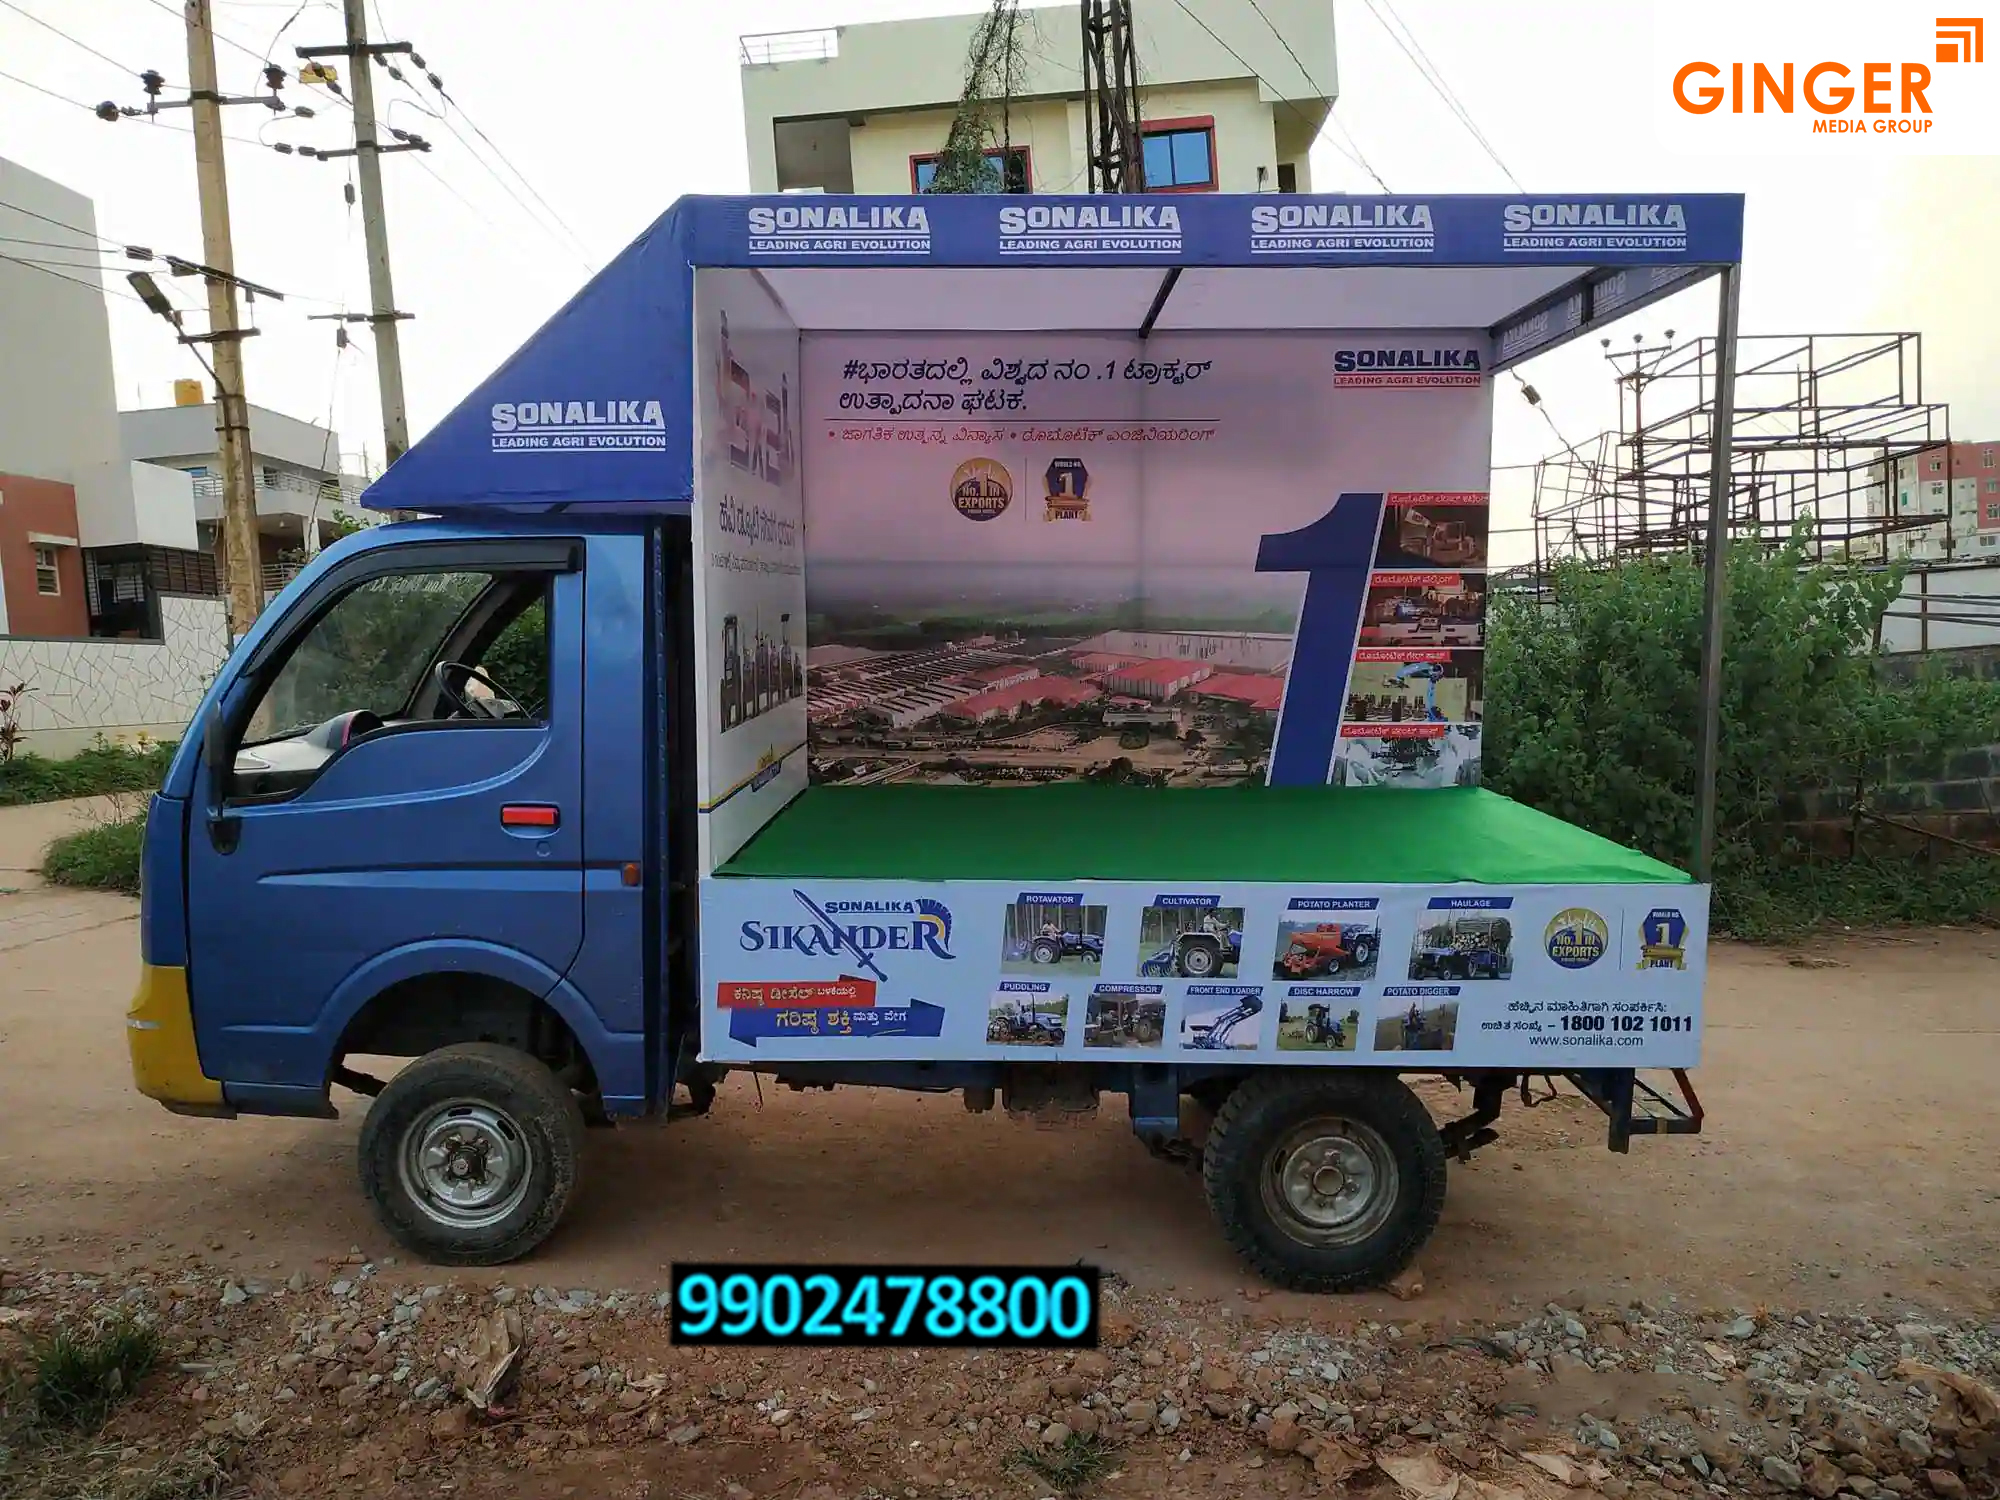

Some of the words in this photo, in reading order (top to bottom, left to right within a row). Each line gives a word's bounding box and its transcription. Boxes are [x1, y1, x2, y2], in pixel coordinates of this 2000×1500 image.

[749, 206, 929, 233] SONALIKA
[1000, 205, 1181, 233] SONALIKA
[1251, 205, 1433, 233] SONALIKA
[1504, 204, 1686, 232] SONALIKA
[749, 239, 808, 251] LEADING
[814, 239, 847, 251] AGRI
[851, 239, 930, 251] EVOLUTION
[1000, 239, 1059, 251] LEADING
[1065, 239, 1098, 251] AGRI
[1102, 239, 1181, 251] EVOLUTION
[1251, 238, 1312, 249] LEADING
[1316, 238, 1350, 249] AGRI
[1355, 238, 1434, 249] EVOLUTION
[1504, 237, 1564, 248] LEADING
[1569, 237, 1602, 248] AGRI
[1607, 237, 1686, 248] EVOLUTION
[1334, 350, 1480, 372] SONALIKA
[1334, 376, 1382, 385] LEADING
[1386, 376, 1413, 385] AGRI
[1416, 376, 1480, 385] EVOLUTION
[492, 401, 666, 432] SONALIKA
[492, 437, 549, 448] LEADING
[553, 437, 584, 447] AGRI
[589, 437, 666, 447] EVOLUTION
[958, 497, 1005, 509] EXPORTS
[1055, 510, 1078, 519] PLANT
[1026, 895, 1074, 904] ROTAVATOR
[1162, 898, 1212, 906] CULTIVATOR
[1297, 900, 1332, 908] POTATO
[1334, 900, 1370, 908] PLANTER
[1451, 900, 1491, 908] HAULAGE
[824, 901, 915, 914] SONALIKA
[740, 920, 957, 959] SIKANDER
[1656, 923, 1672, 946] 1
[1552, 946, 1600, 957] EXPORTS
[1003, 983, 1046, 991] PUDDLING
[1099, 985, 1157, 993] COMPRESSOR
[1190, 986, 1214, 994] FRONT
[1216, 987, 1230, 995] END
[1232, 987, 1261, 995] LOADER
[1294, 987, 1314, 996] DISC
[1316, 987, 1353, 996] HARROW
[1387, 987, 1418, 995] POTATO
[1420, 987, 1450, 995] DIGGER
[1560, 1015, 1604, 1032] 1800
[1611, 1015, 1644, 1032] 102
[1650, 1015, 1692, 1032] 1011
[1529, 1035, 1643, 1047] www.sonalika.com
